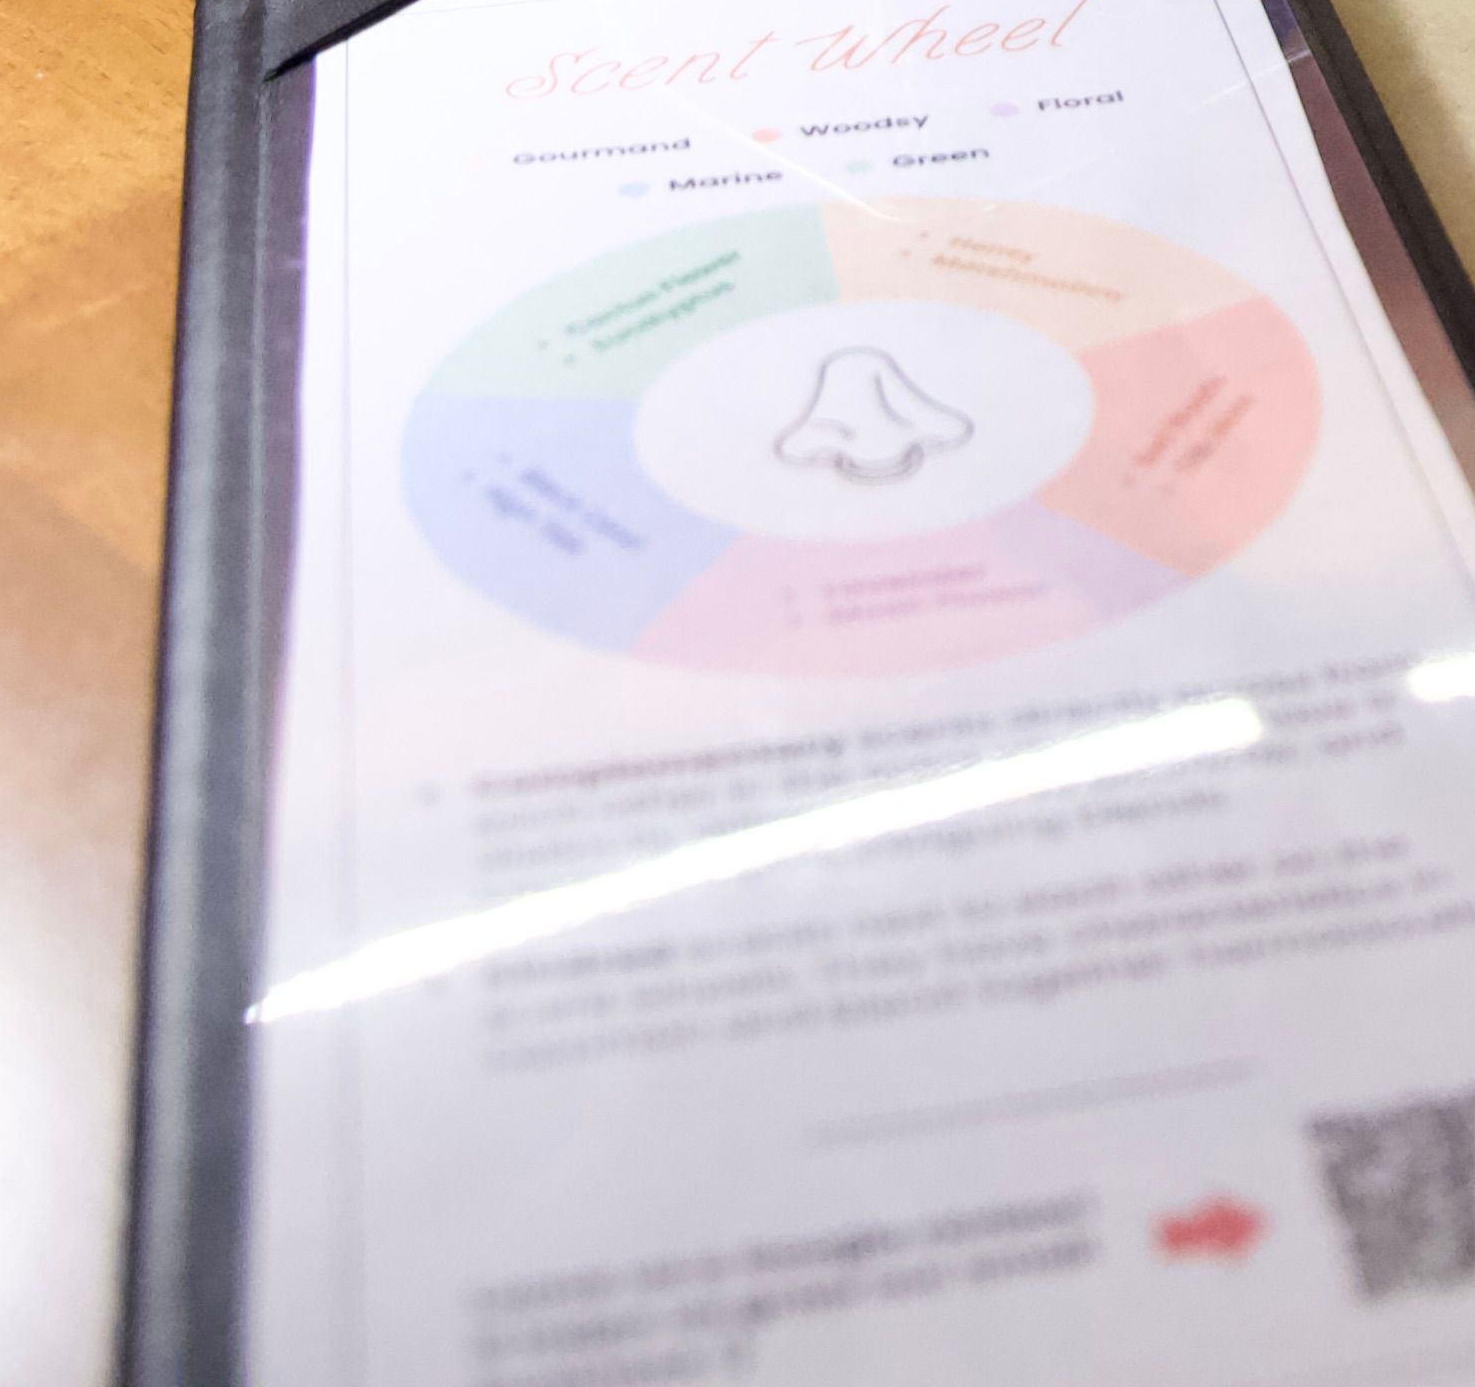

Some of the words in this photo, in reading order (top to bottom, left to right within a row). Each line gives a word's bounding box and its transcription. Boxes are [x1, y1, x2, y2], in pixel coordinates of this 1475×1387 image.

[505, 30, 782, 100] Scent
[512, 136, 692, 165] Gourmand
[799, 113, 930, 139] Woodsy
[1036, 89, 1125, 112] Floral
[668, 169, 785, 193] Marine
[891, 147, 992, 169] Green
